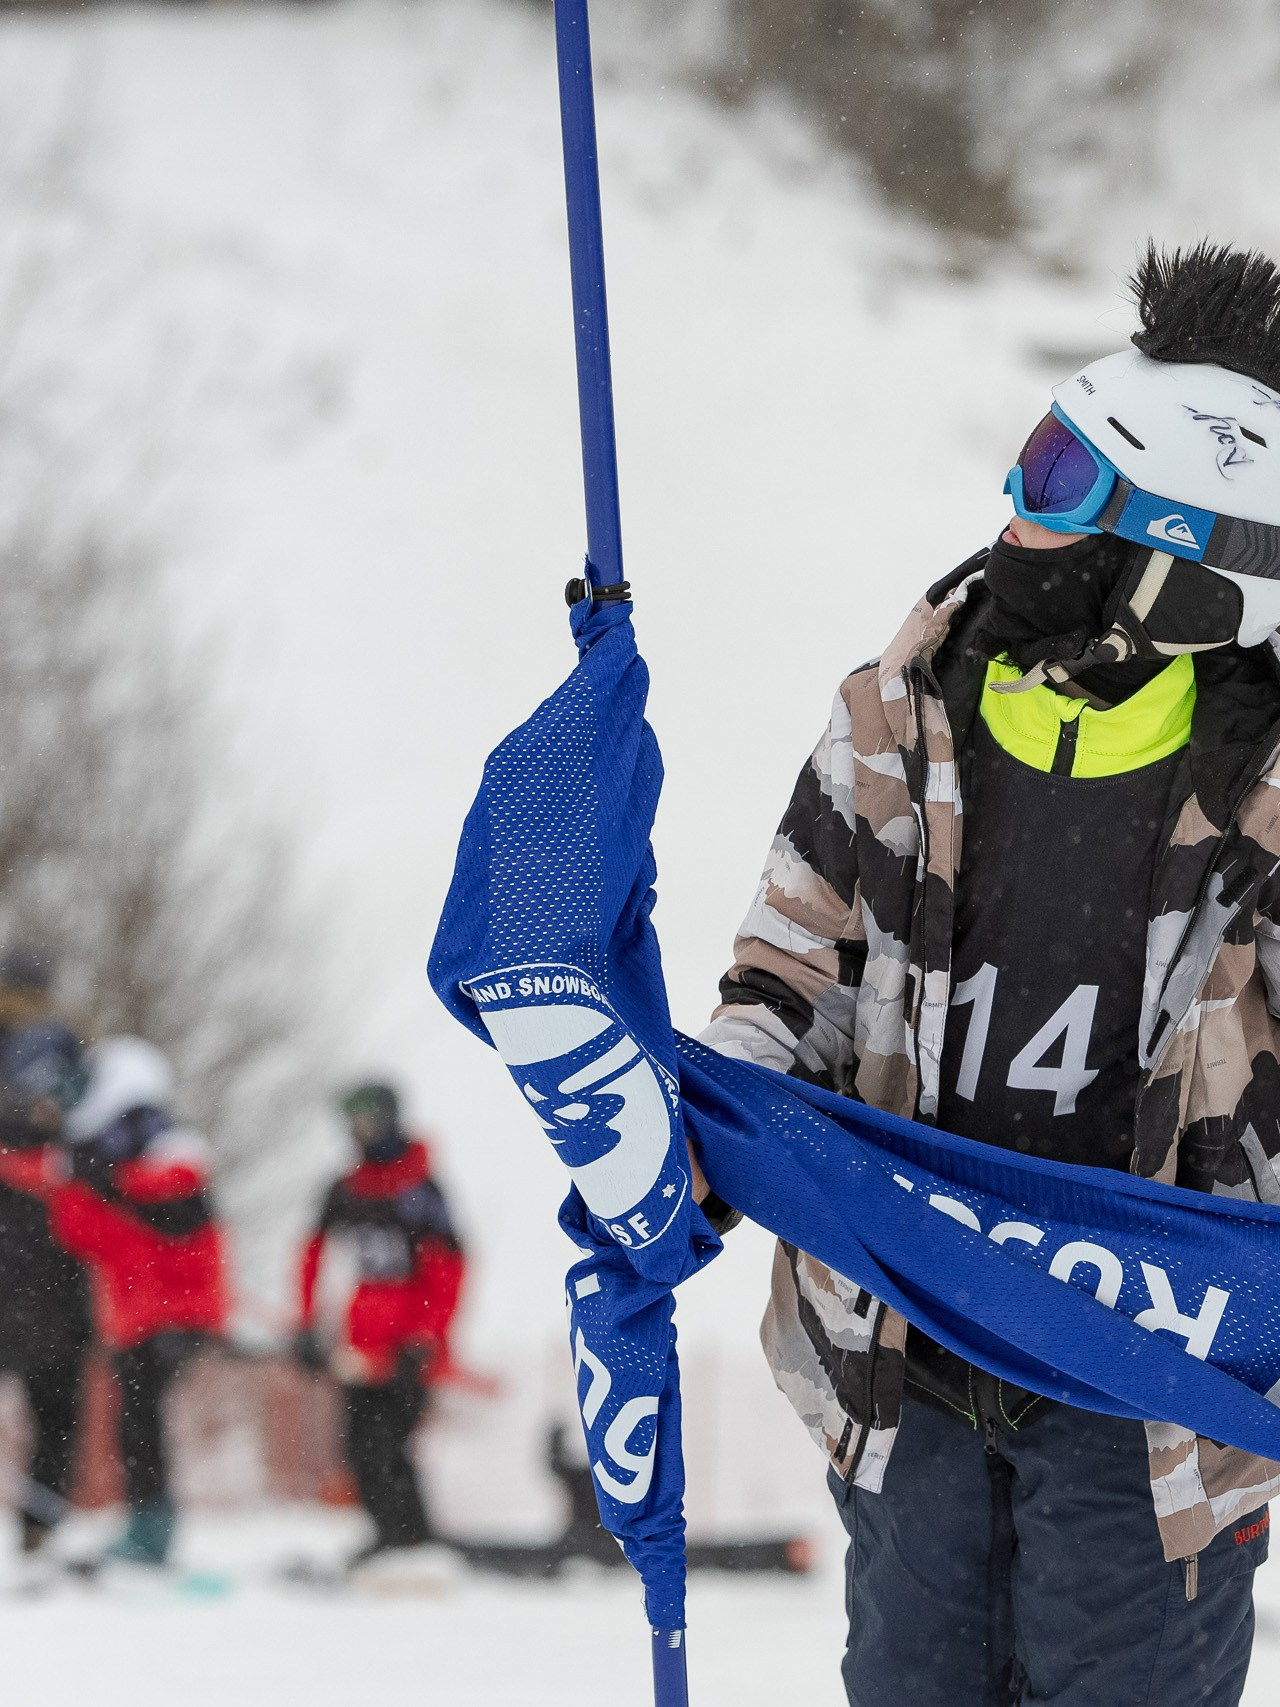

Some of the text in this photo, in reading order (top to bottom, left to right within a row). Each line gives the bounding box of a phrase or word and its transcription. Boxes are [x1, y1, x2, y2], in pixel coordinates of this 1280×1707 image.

[1076, 375, 1096, 396] SMITH
[951, 962, 1099, 1116] 14
[1206, 1058, 1227, 1069] TERMIT
